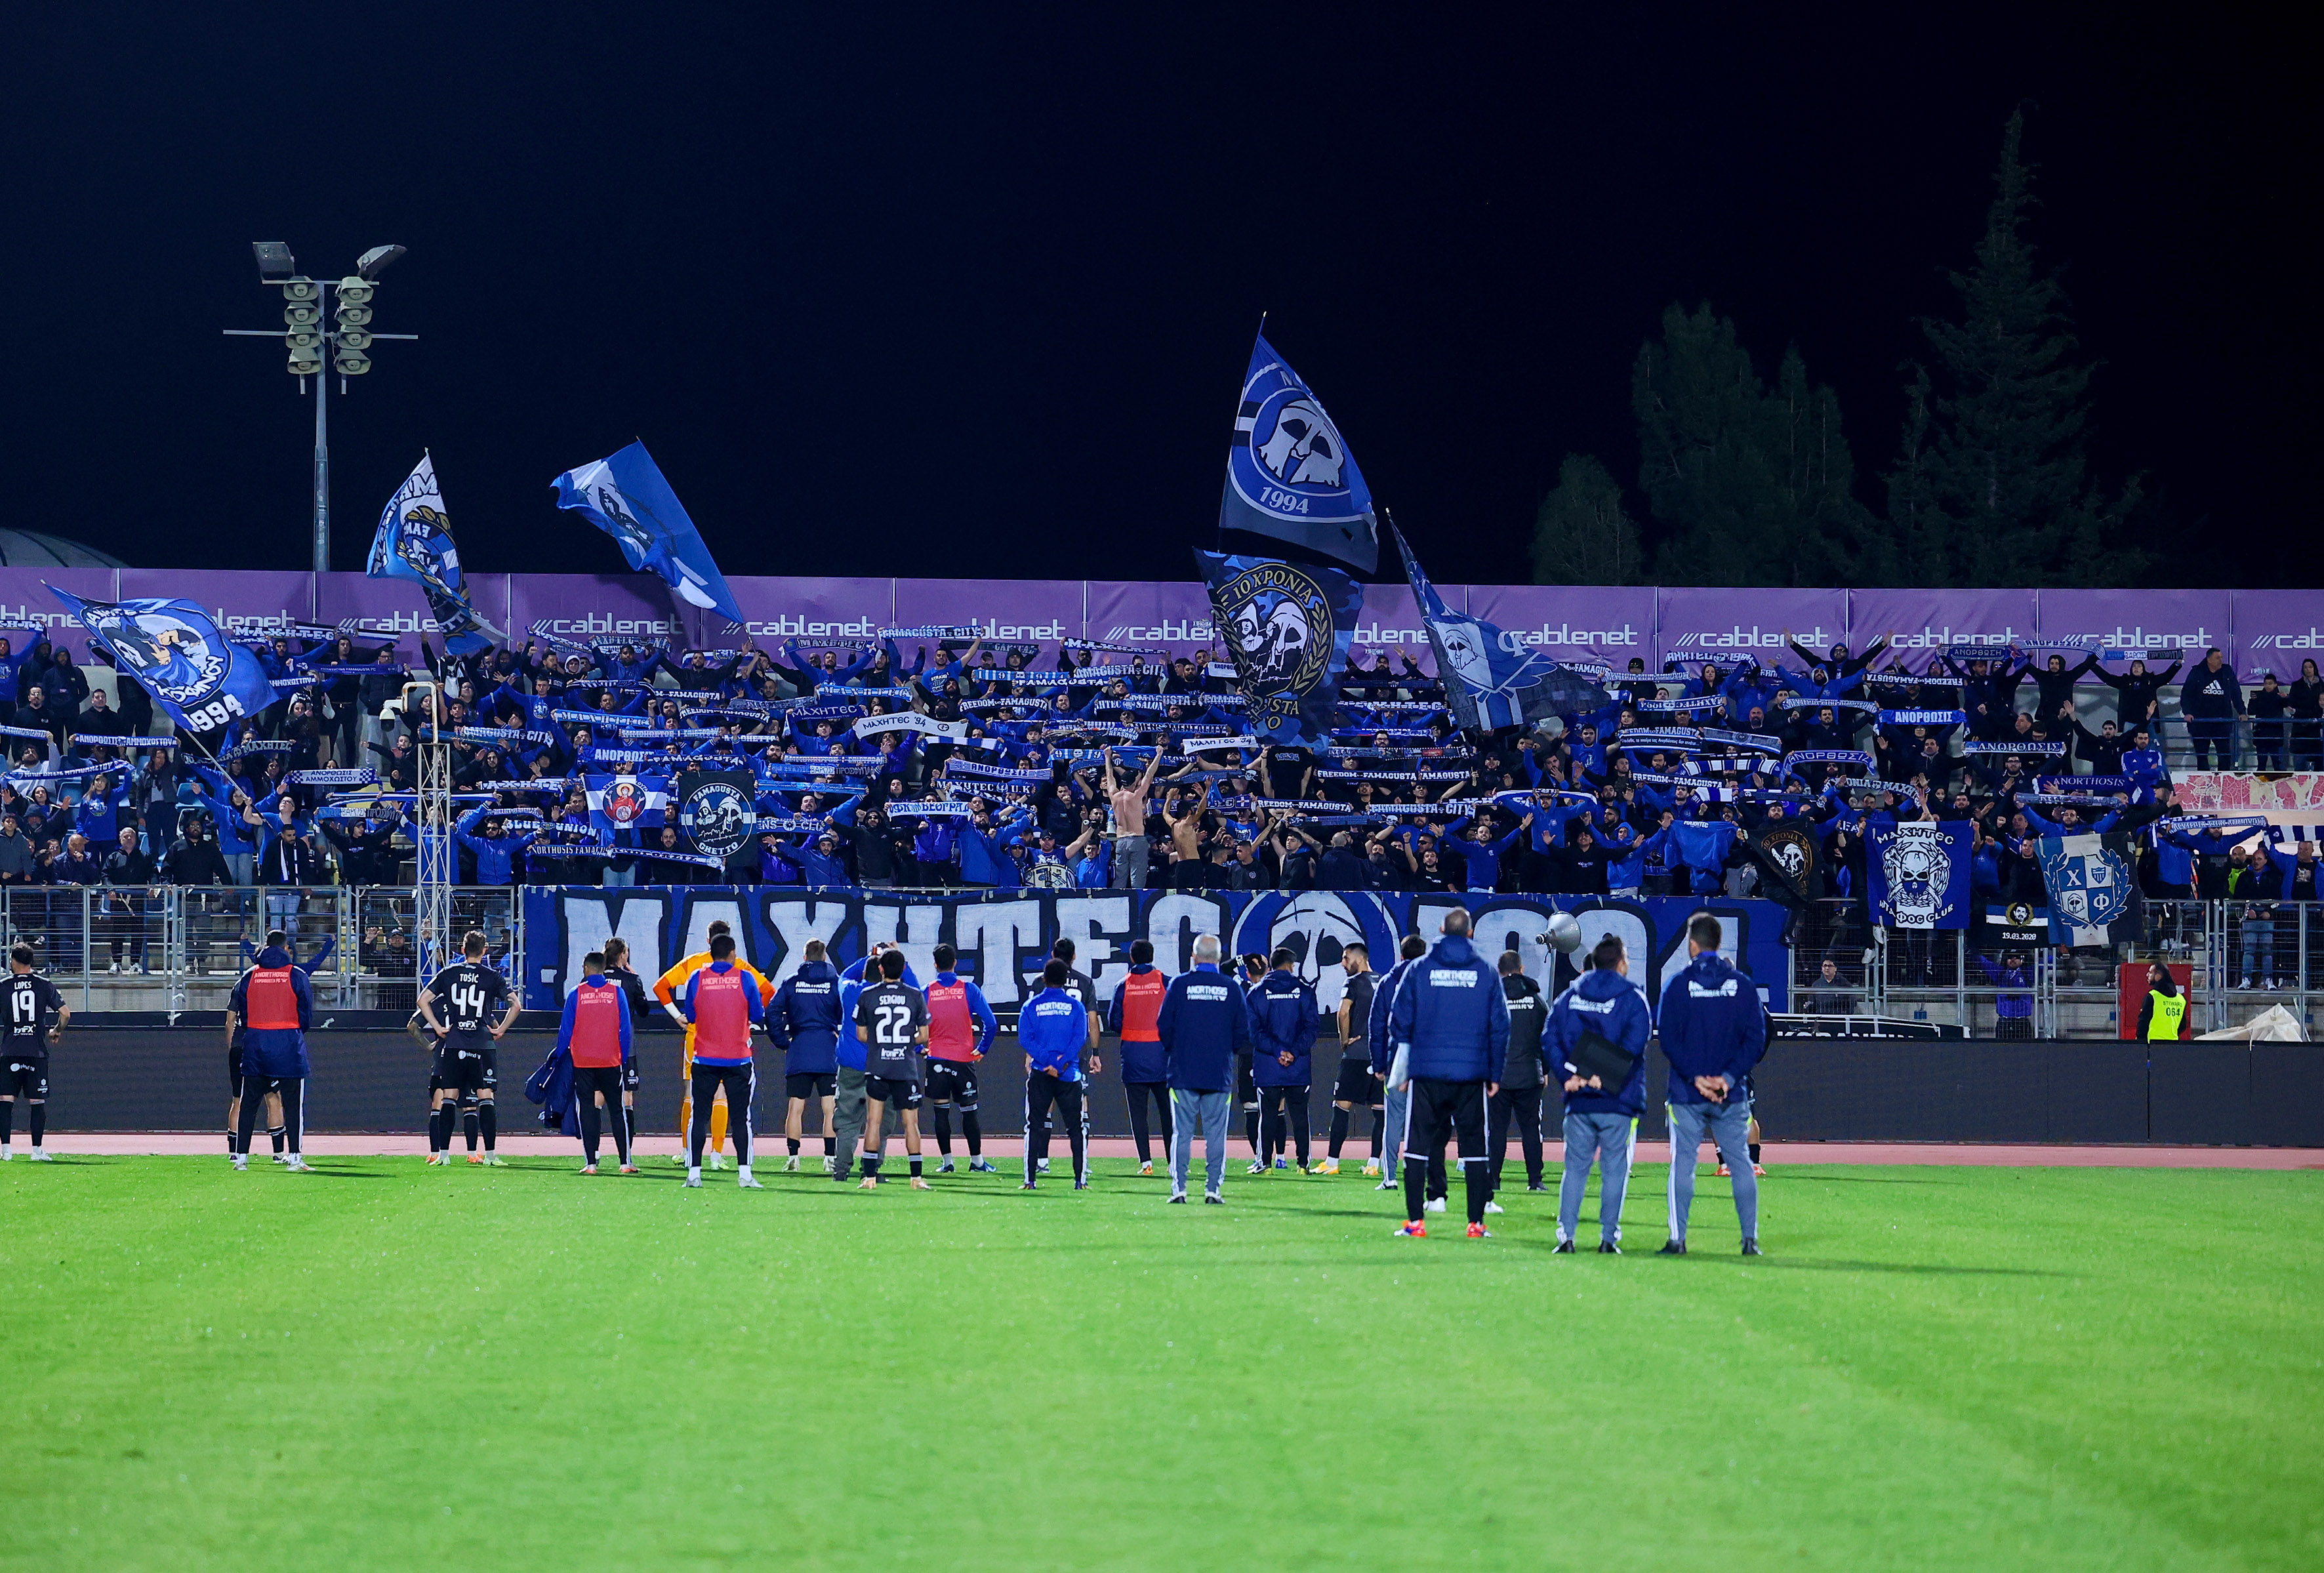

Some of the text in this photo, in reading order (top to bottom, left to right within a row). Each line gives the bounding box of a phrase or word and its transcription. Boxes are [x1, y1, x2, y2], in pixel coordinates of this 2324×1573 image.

[1259, 487, 1309, 514] 1994
[553, 612, 683, 635] cablenet
[746, 615, 875, 637] cablenet
[954, 626, 979, 637] CITY
[1890, 626, 2020, 648] cablenet
[1000, 699, 1048, 712] FAMAGUSTA
[184, 693, 246, 732] 1994
[1895, 711, 1953, 723] ΑΝΟΡΘΩΣΙΣ
[1656, 726, 1700, 736] FAMAGUSTA
[1978, 743, 2060, 752] ΑΝΟΡΘΩΣΙΣ
[1317, 770, 1417, 781] FREEDOM FAMAGUSTA
[1419, 770, 1470, 780] AMAGUSTA
[1633, 773, 1723, 787] FREEDOM FAMAGUSTA
[2054, 777, 2125, 787] ANORTHOSIS
[693, 785, 741, 802] FAMAGUSTA
[1298, 801, 1352, 813] FAMAGUSTA
[505, 820, 600, 840] BLUE UNION
[699, 841, 739, 855] GHETTO
[2093, 893, 2110, 910] Φ
[1926, 903, 1954, 923] CLUB
[2003, 932, 2037, 941] 19.03.2020
[459, 972, 479, 983] TOŠIĆ
[701, 976, 740, 986] ANORTHOSIS
[1429, 969, 1478, 981] ANORTHOSIS
[14, 981, 31, 990] LOPES
[1187, 985, 1228, 995] ANORTHOSIS
[930, 988, 964, 997] ANORTHOSIS
[451, 983, 485, 1017] 44
[879, 994, 906, 1006] SERGIOU
[11, 990, 35, 1023] 19
[1036, 1002, 1072, 1011] ANORTHOSIS
[2166, 1008, 2181, 1017] 064
[874, 1006, 911, 1044] 22
[881, 1048, 904, 1057] IronFX
